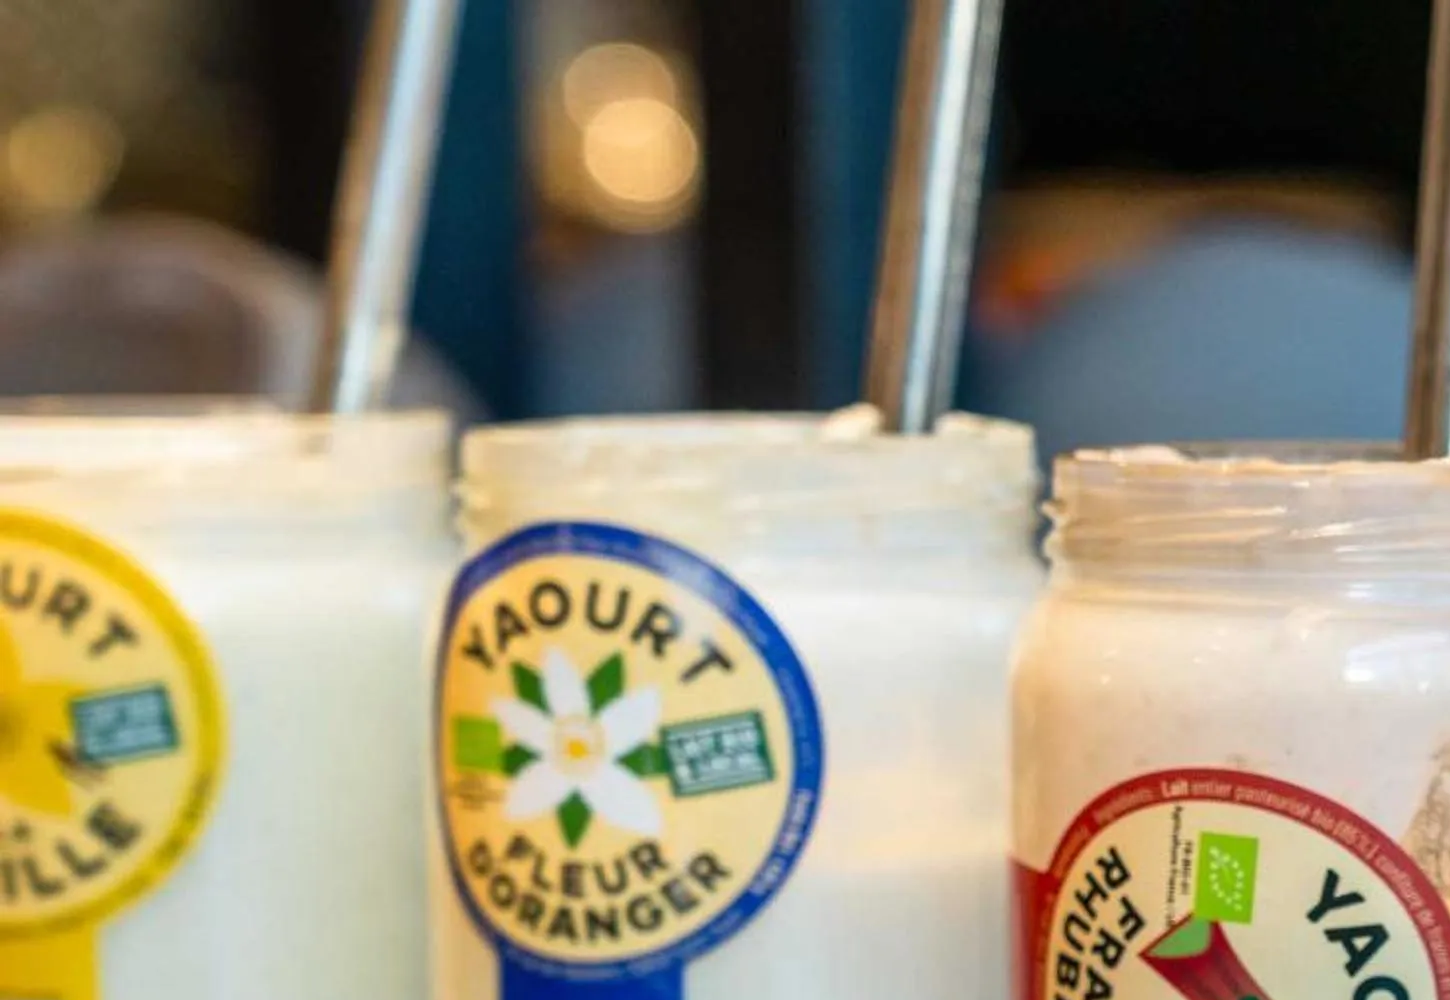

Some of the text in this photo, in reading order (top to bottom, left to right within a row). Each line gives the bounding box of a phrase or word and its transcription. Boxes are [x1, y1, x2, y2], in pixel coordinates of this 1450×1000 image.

[0, 564, 139, 657] URT
[462, 581, 733, 684] YAOURT
[0, 803, 141, 903] ILLE
[505, 832, 668, 898] FLEUR
